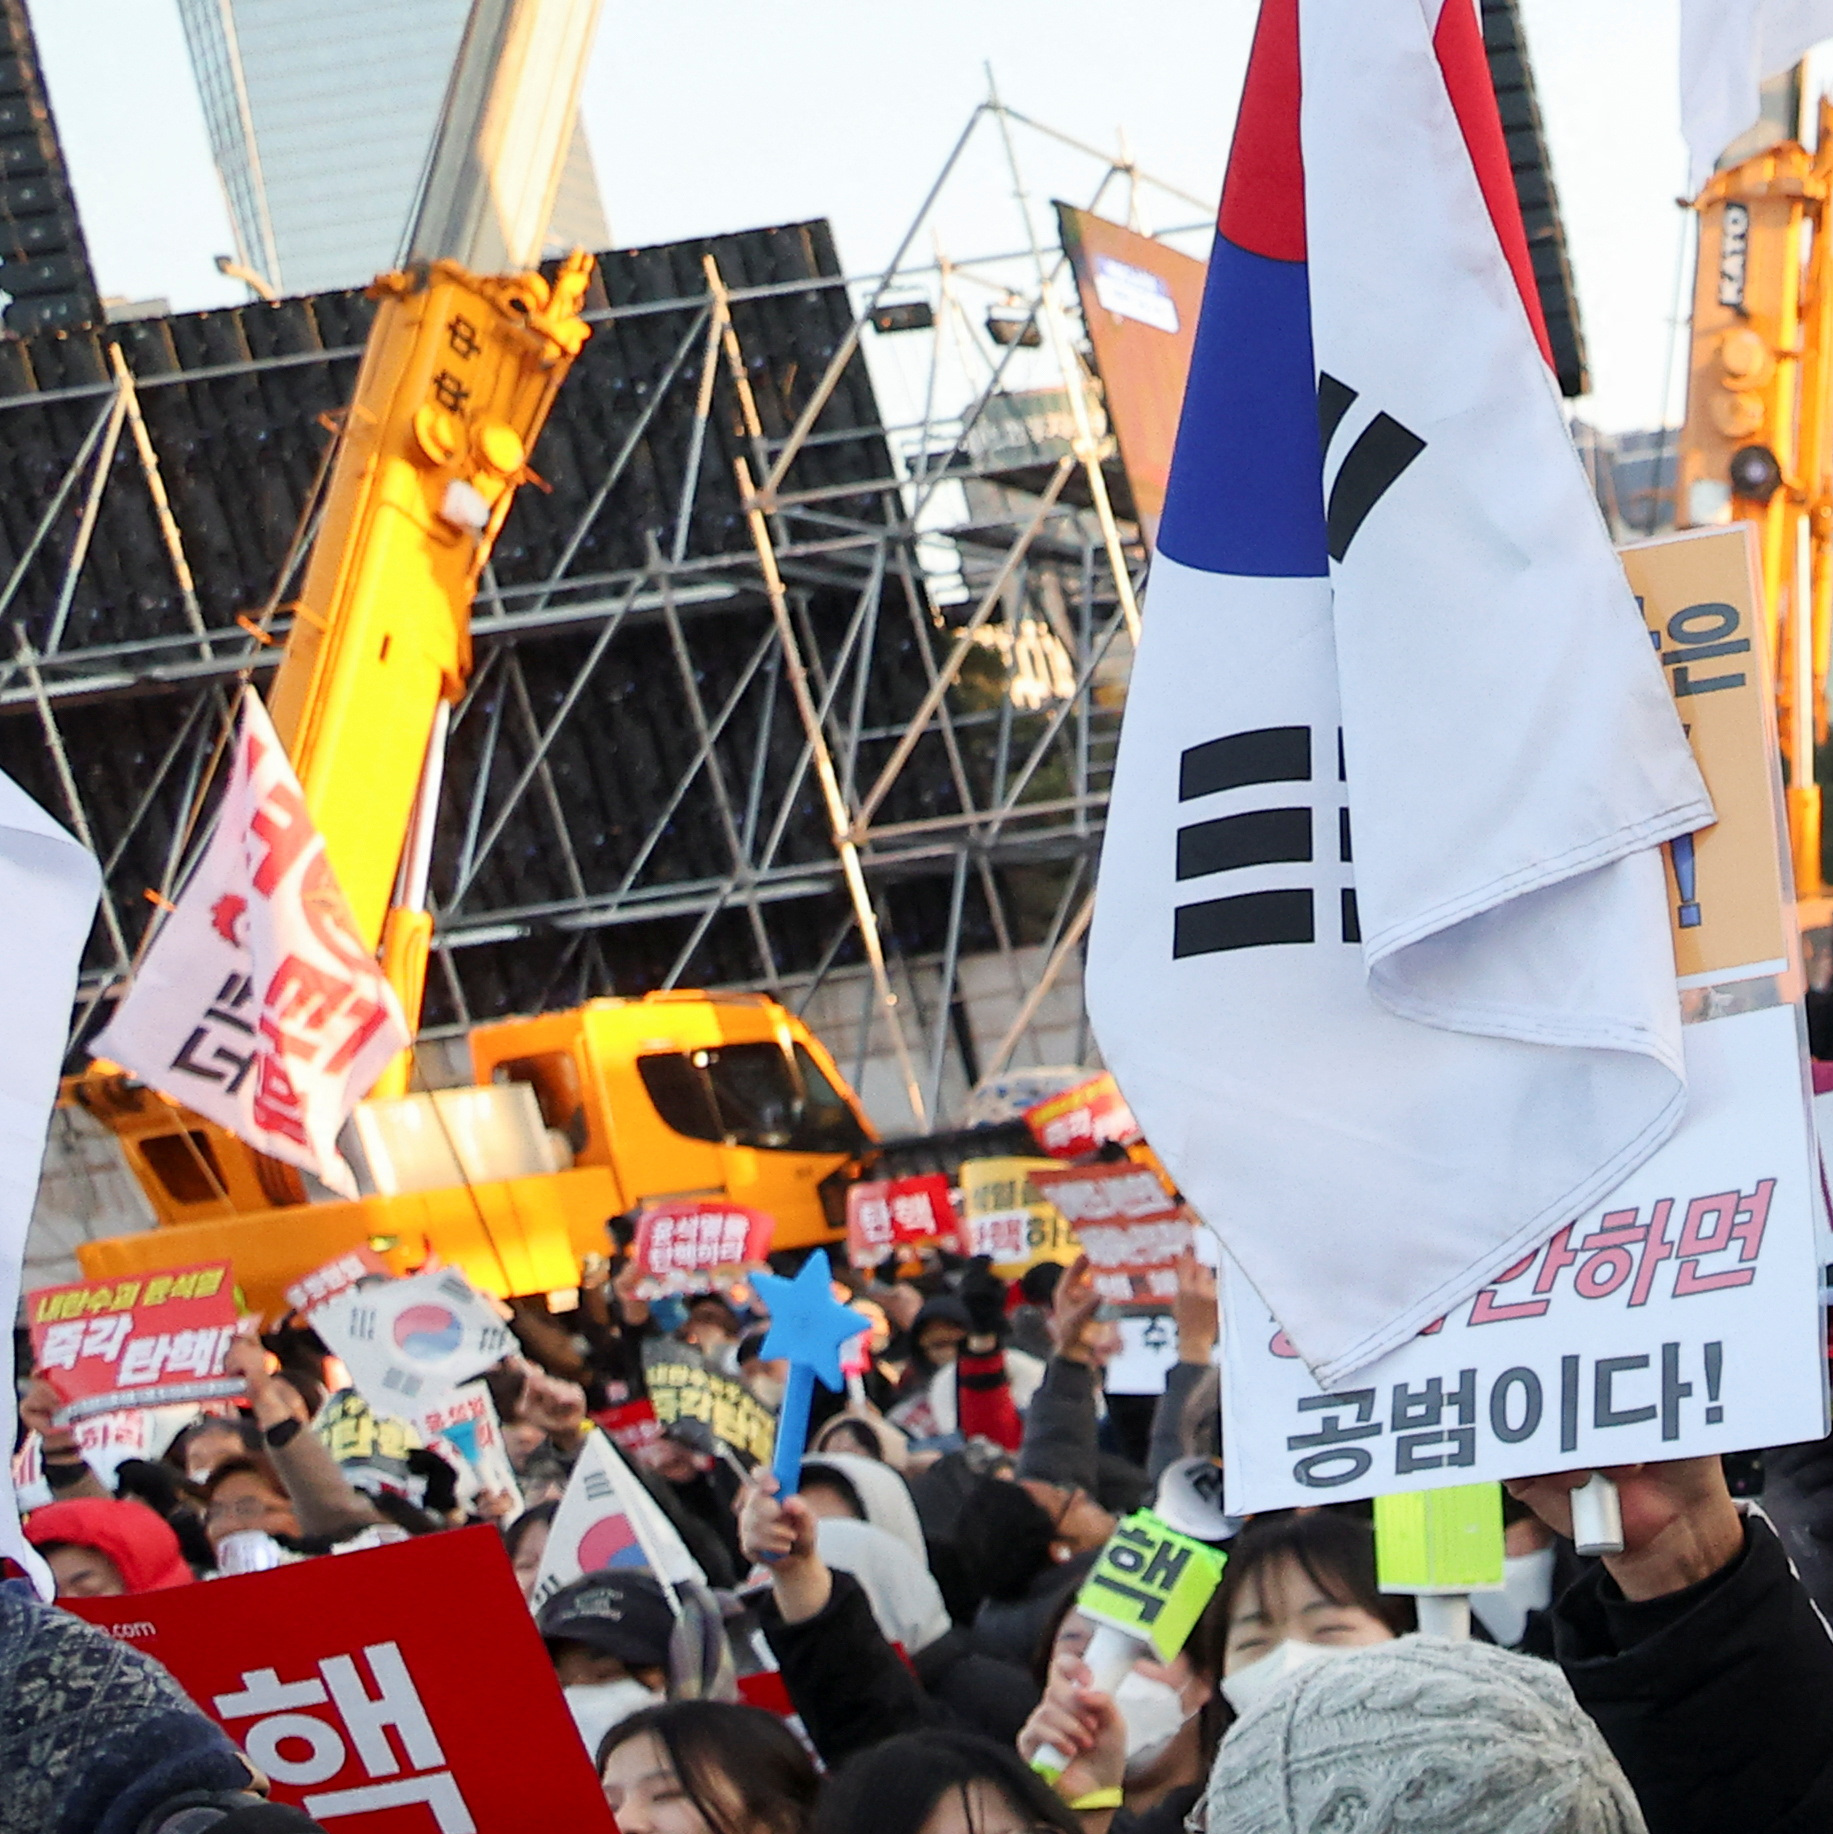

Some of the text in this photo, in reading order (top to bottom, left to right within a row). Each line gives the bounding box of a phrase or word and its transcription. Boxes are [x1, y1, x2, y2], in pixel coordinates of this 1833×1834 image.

[1719, 203, 1749, 307] KATO
[36, 1281, 142, 1323] 내란수괴
[41, 1312, 134, 1371] 즉각
[115, 1321, 240, 1389] 탄핵!
[1286, 1340, 1726, 1489] 공범이다!
[1093, 1526, 1195, 1625] 핵
